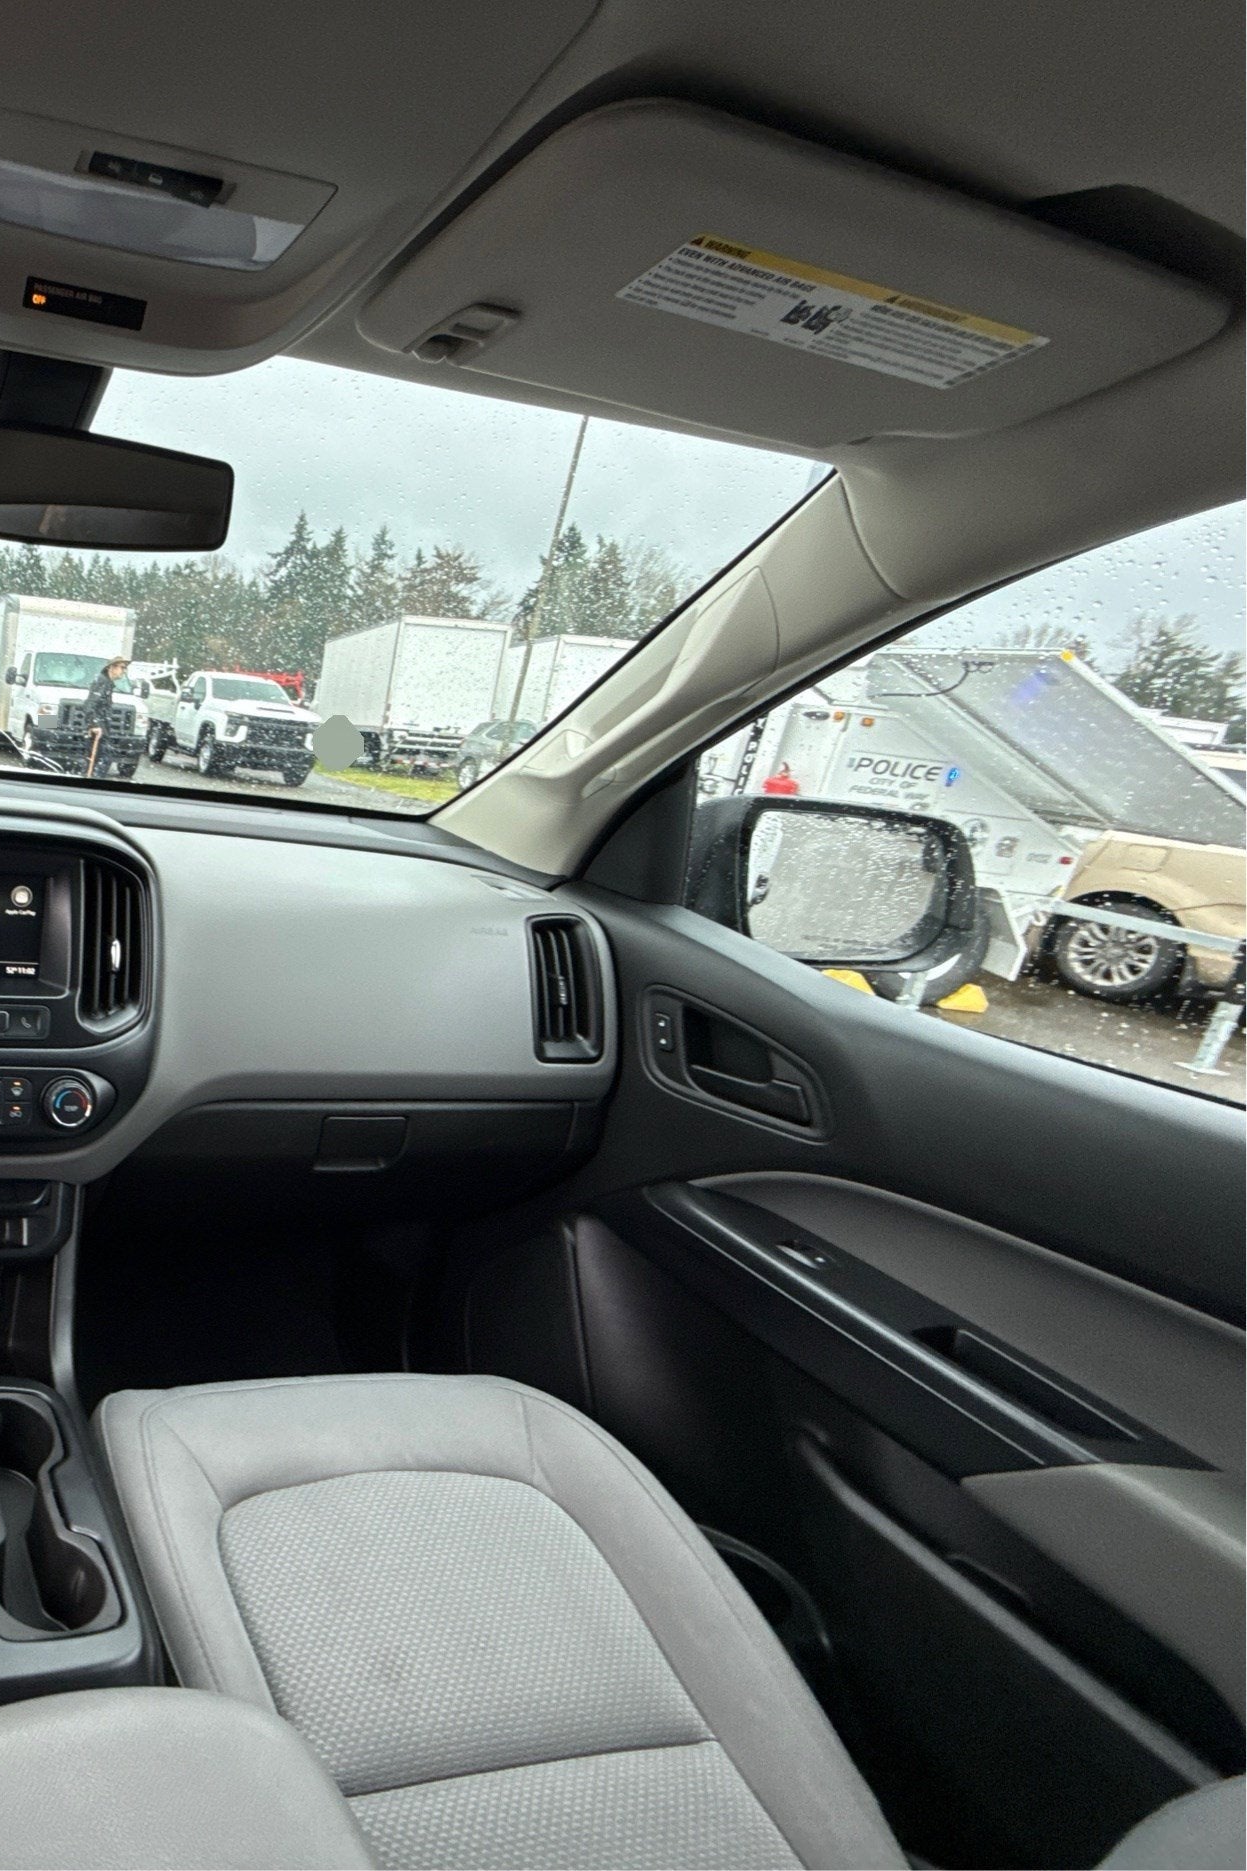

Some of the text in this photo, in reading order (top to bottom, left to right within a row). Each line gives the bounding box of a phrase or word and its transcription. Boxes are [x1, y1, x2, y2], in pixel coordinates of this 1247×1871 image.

[677, 247, 705, 261] EVEN
[702, 254, 727, 267] WITH
[726, 258, 776, 281] ADVANCED
[853, 757, 943, 782] POLICE
[848, 784, 899, 798] FEDERAL
[868, 776, 918, 789] CITY OF
